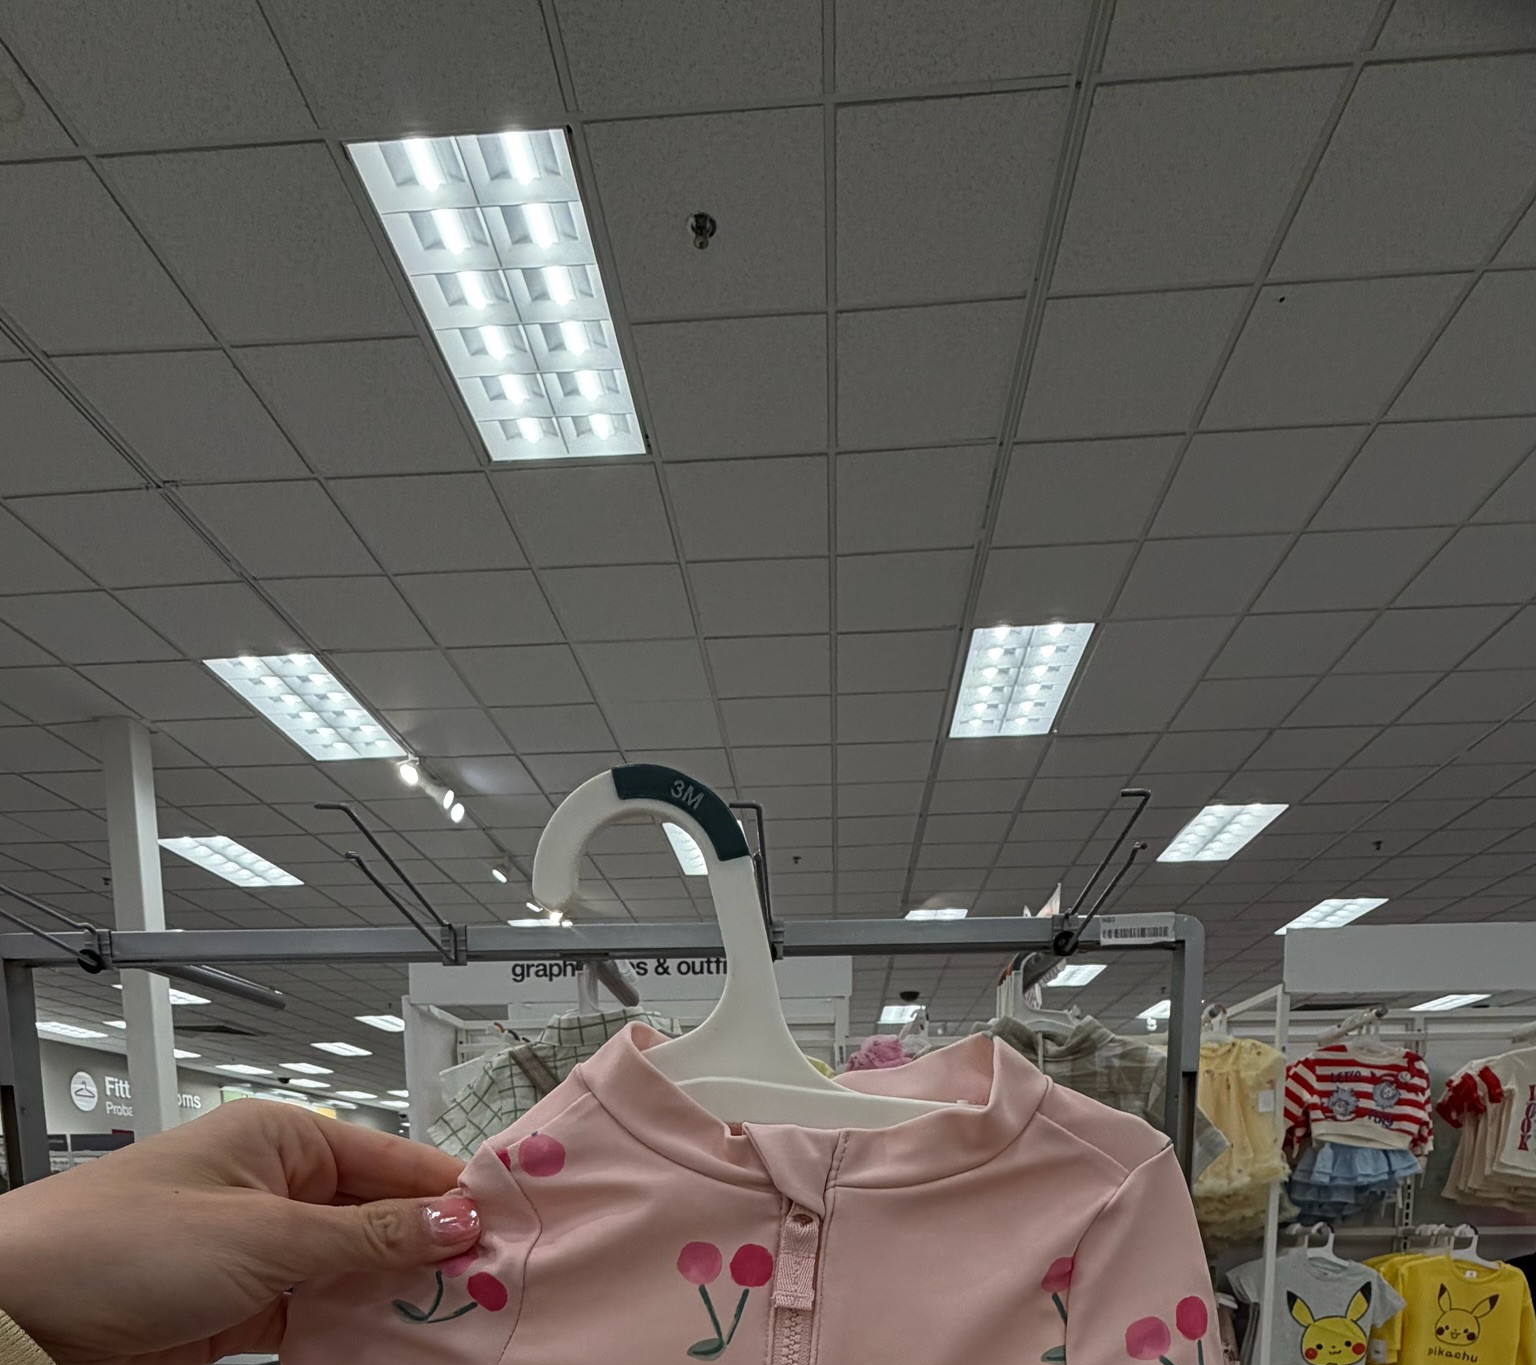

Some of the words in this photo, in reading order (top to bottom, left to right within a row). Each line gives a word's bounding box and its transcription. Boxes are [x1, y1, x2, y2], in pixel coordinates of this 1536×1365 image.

[669, 779, 705, 810] 3M
[511, 960, 577, 983] graph
[654, 958, 671, 976] &
[677, 958, 728, 976] outfi
[104, 1076, 132, 1099] Fitt
[105, 1101, 133, 1117] Proba
[1428, 1346, 1478, 1363] pikachu
